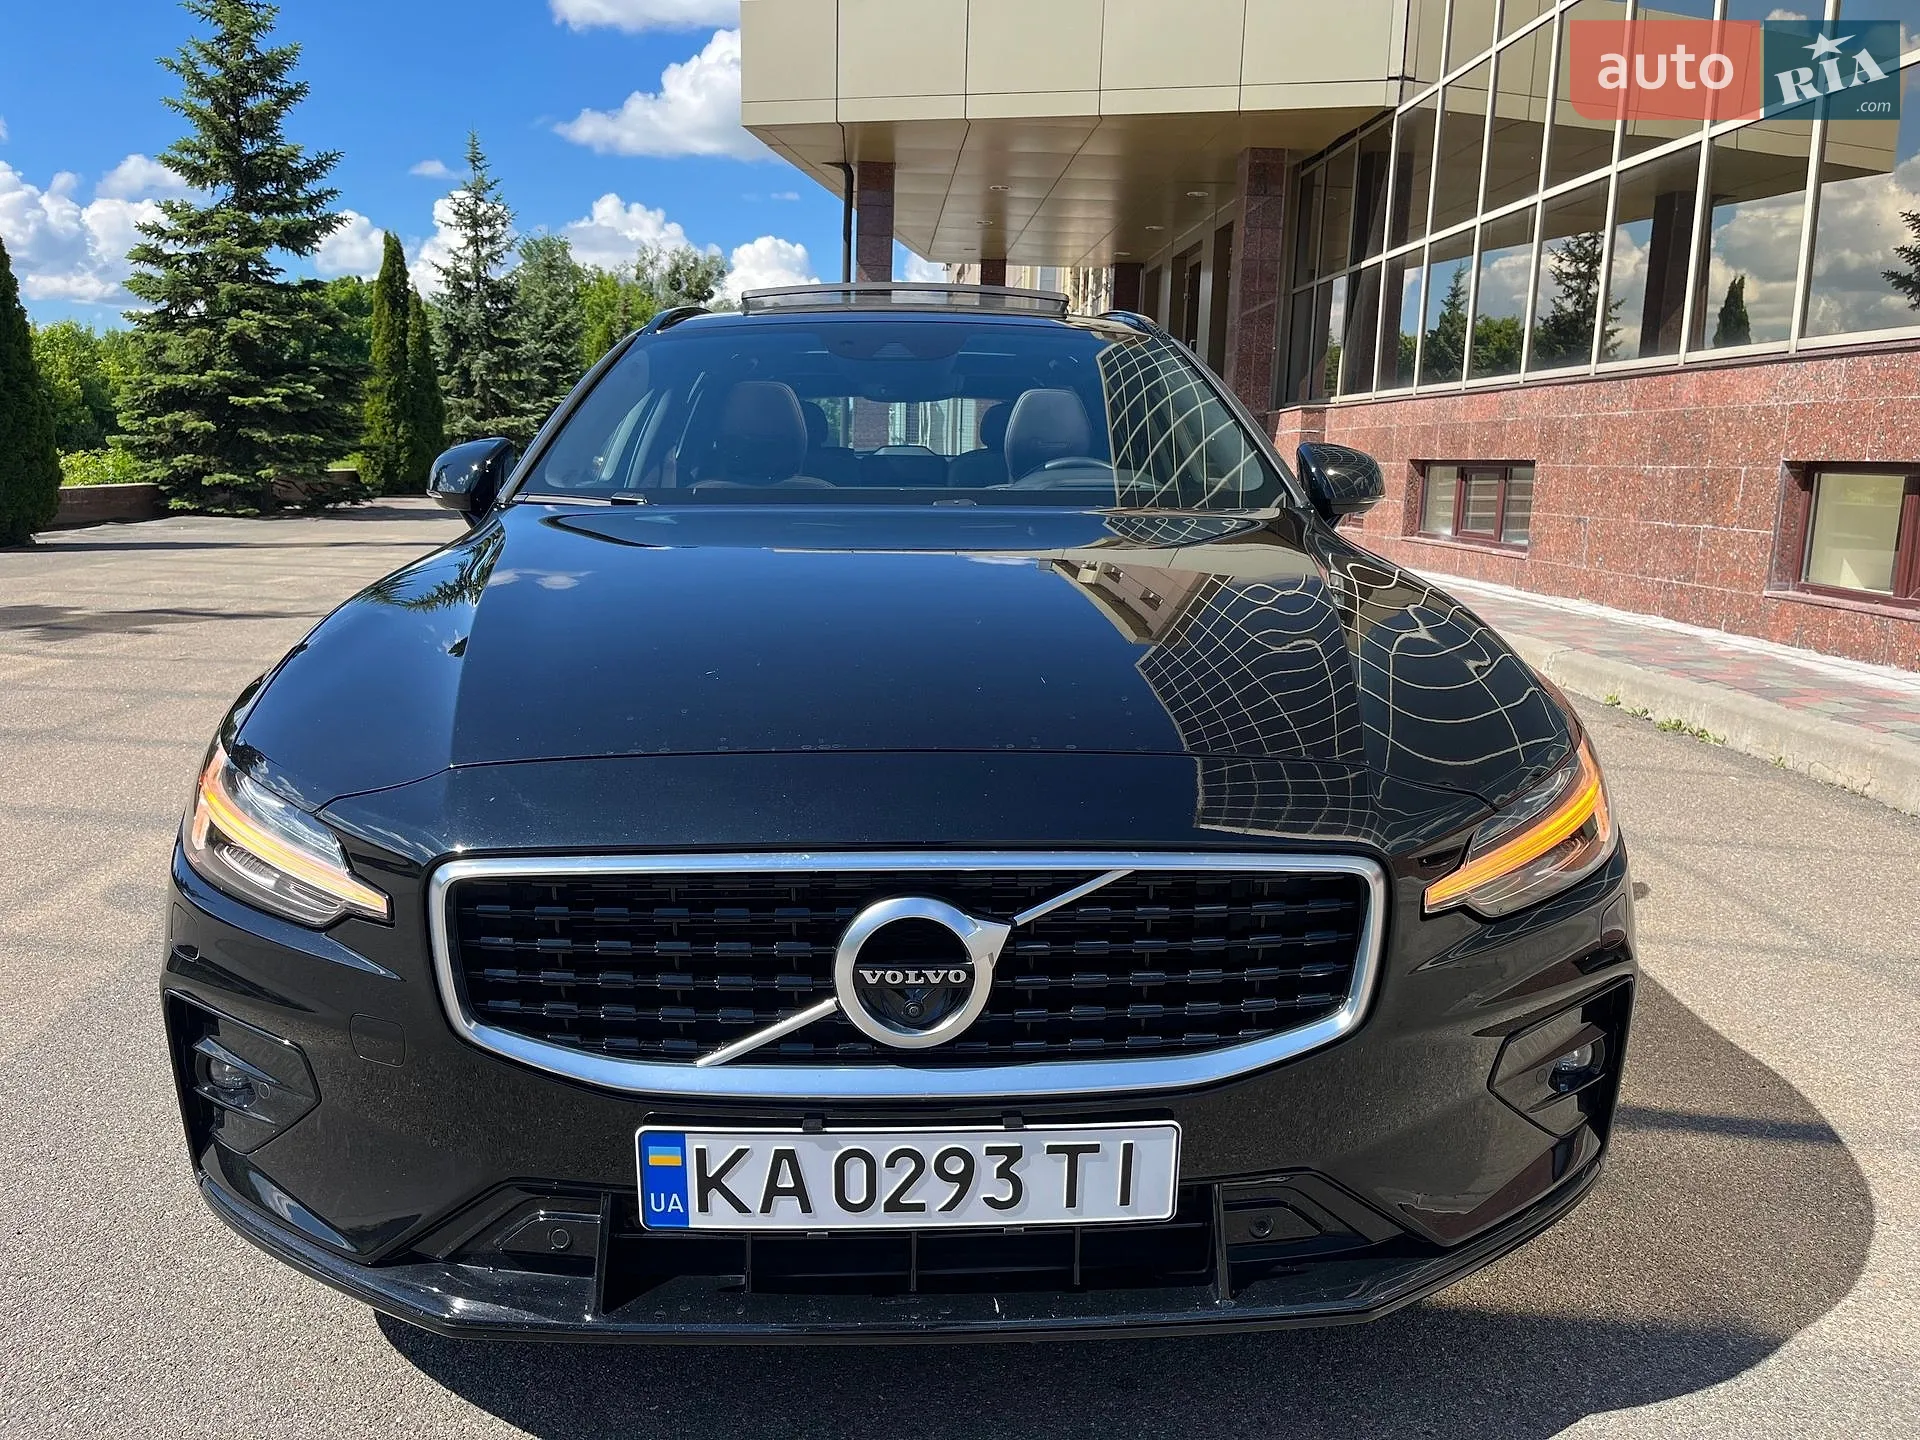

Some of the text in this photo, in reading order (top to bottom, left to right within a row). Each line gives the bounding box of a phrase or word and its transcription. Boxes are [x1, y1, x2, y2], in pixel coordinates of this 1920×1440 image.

[859, 969, 967, 984] VOLVO
[694, 1142, 1134, 1214] KA 0293 TI
[651, 1193, 684, 1213] UA
